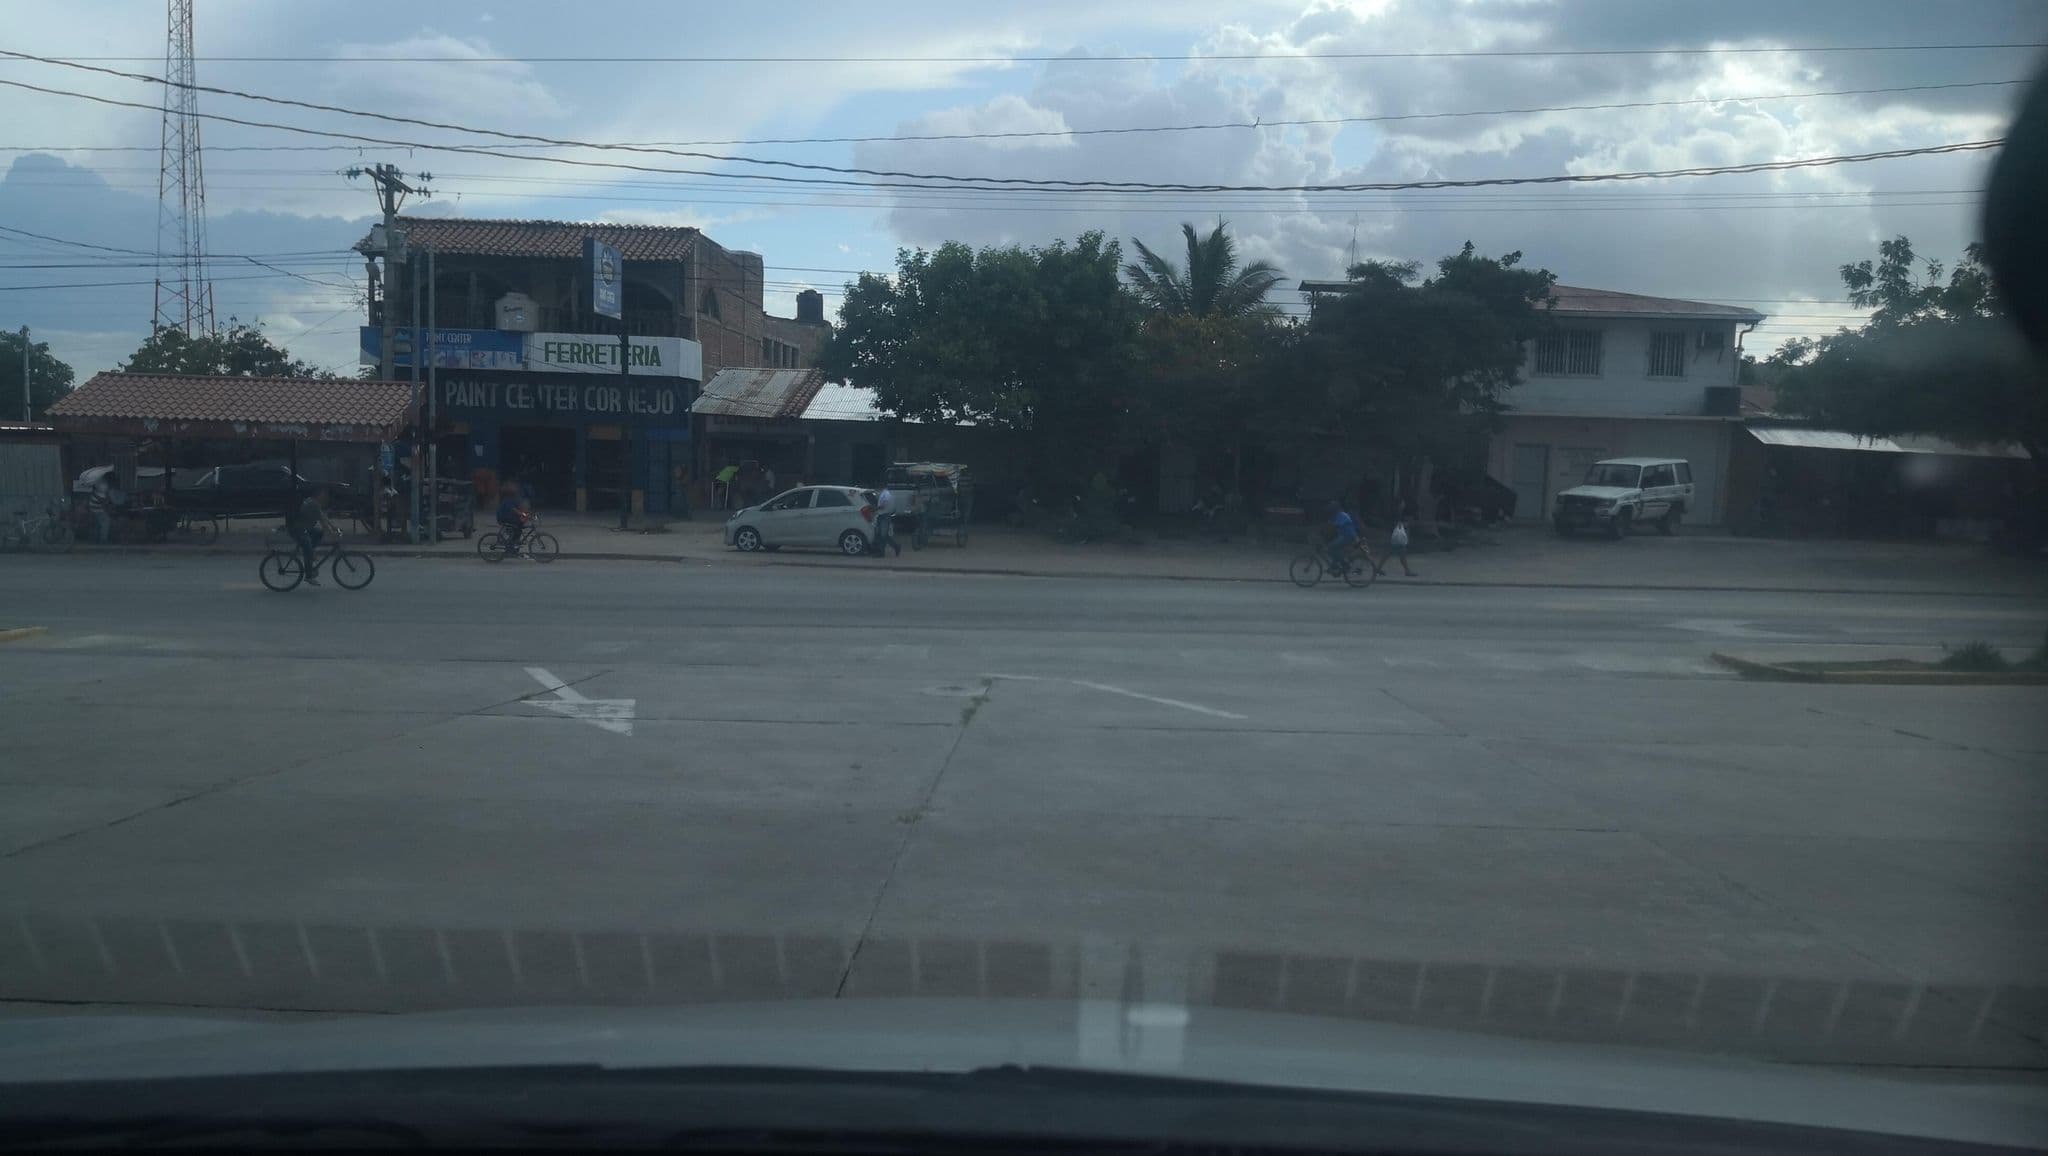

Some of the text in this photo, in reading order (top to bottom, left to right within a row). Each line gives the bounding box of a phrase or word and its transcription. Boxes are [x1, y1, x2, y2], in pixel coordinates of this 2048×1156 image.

[447, 332, 472, 344] CENTER
[544, 341, 662, 367] FERRETERIA
[445, 380, 674, 415] PAINT CENTER CORNEJO
